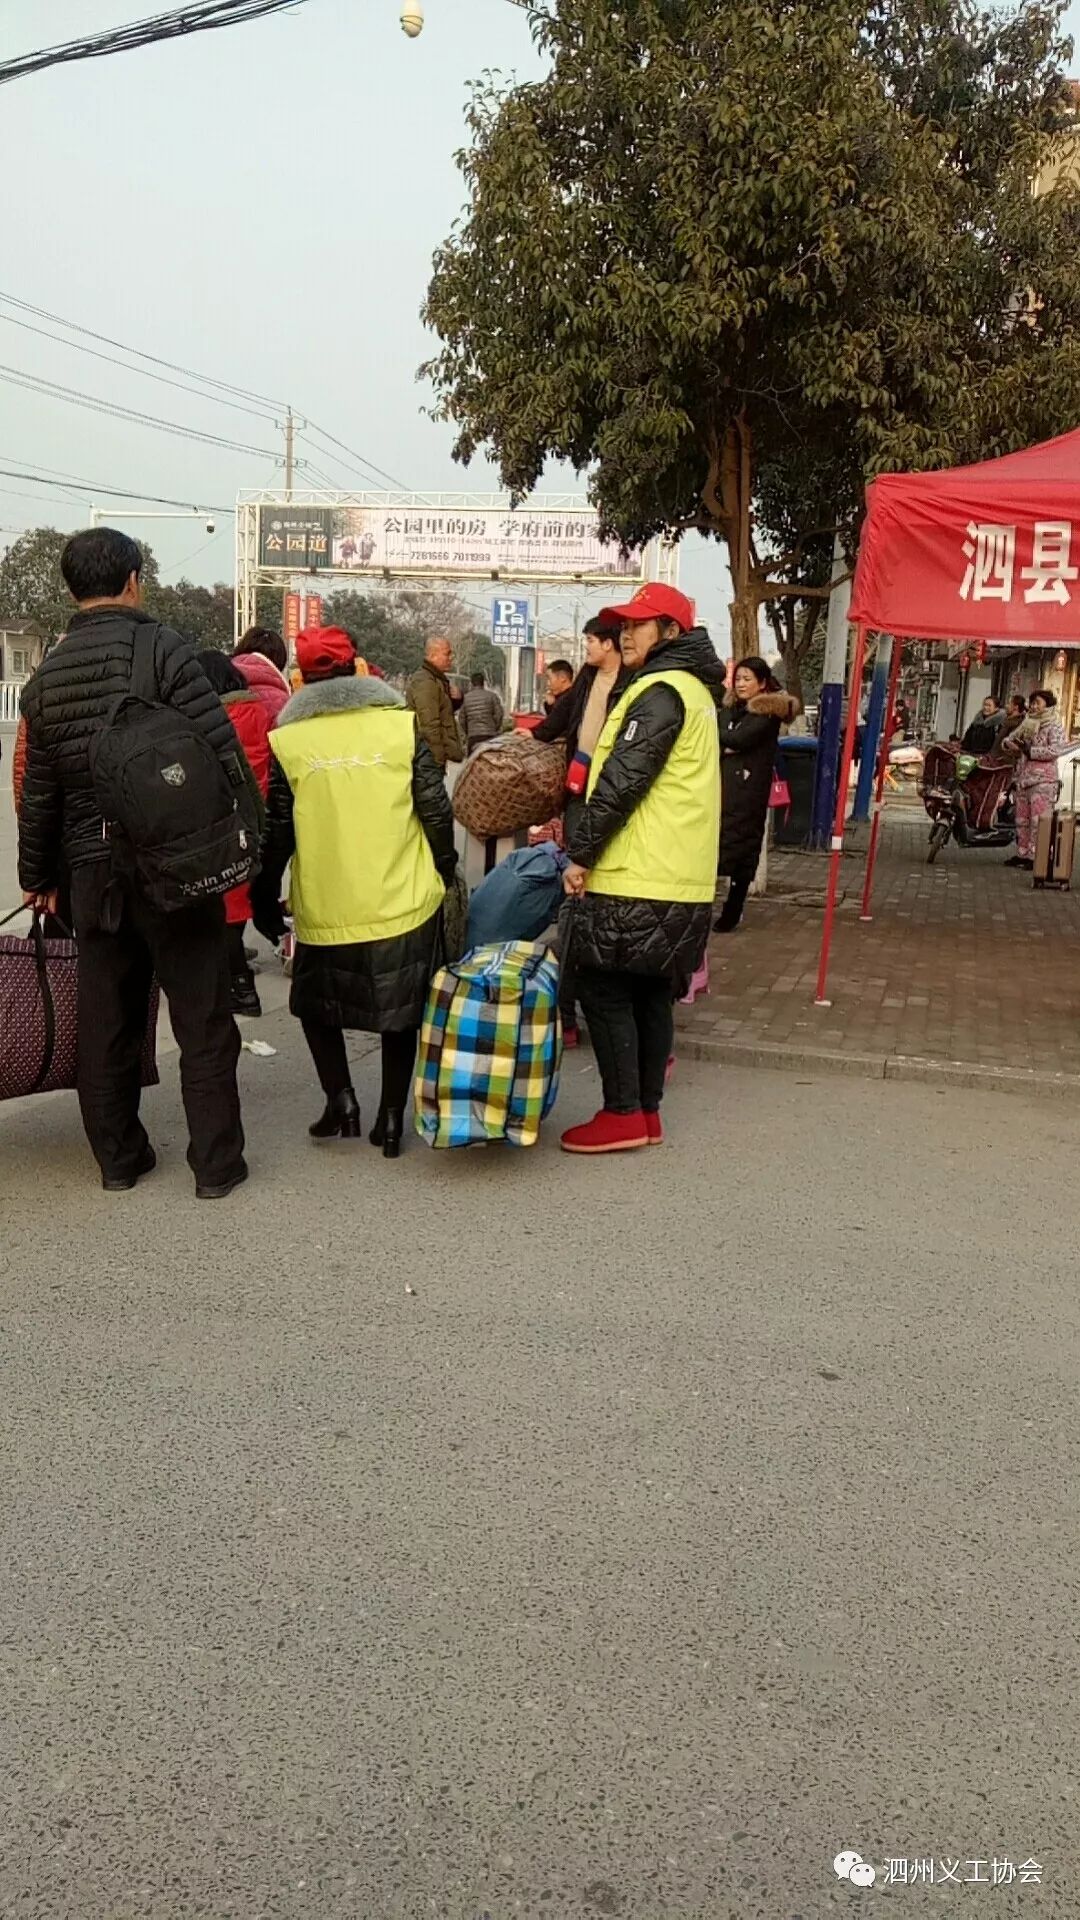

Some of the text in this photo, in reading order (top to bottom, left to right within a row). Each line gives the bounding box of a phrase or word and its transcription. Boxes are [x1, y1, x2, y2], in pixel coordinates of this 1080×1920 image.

[384, 517, 486, 536] 公园里的房
[265, 533, 328, 552] 公园道
[958, 520, 1079, 607] 泗县
[495, 600, 516, 626] P
[220, 856, 252, 880] miao
